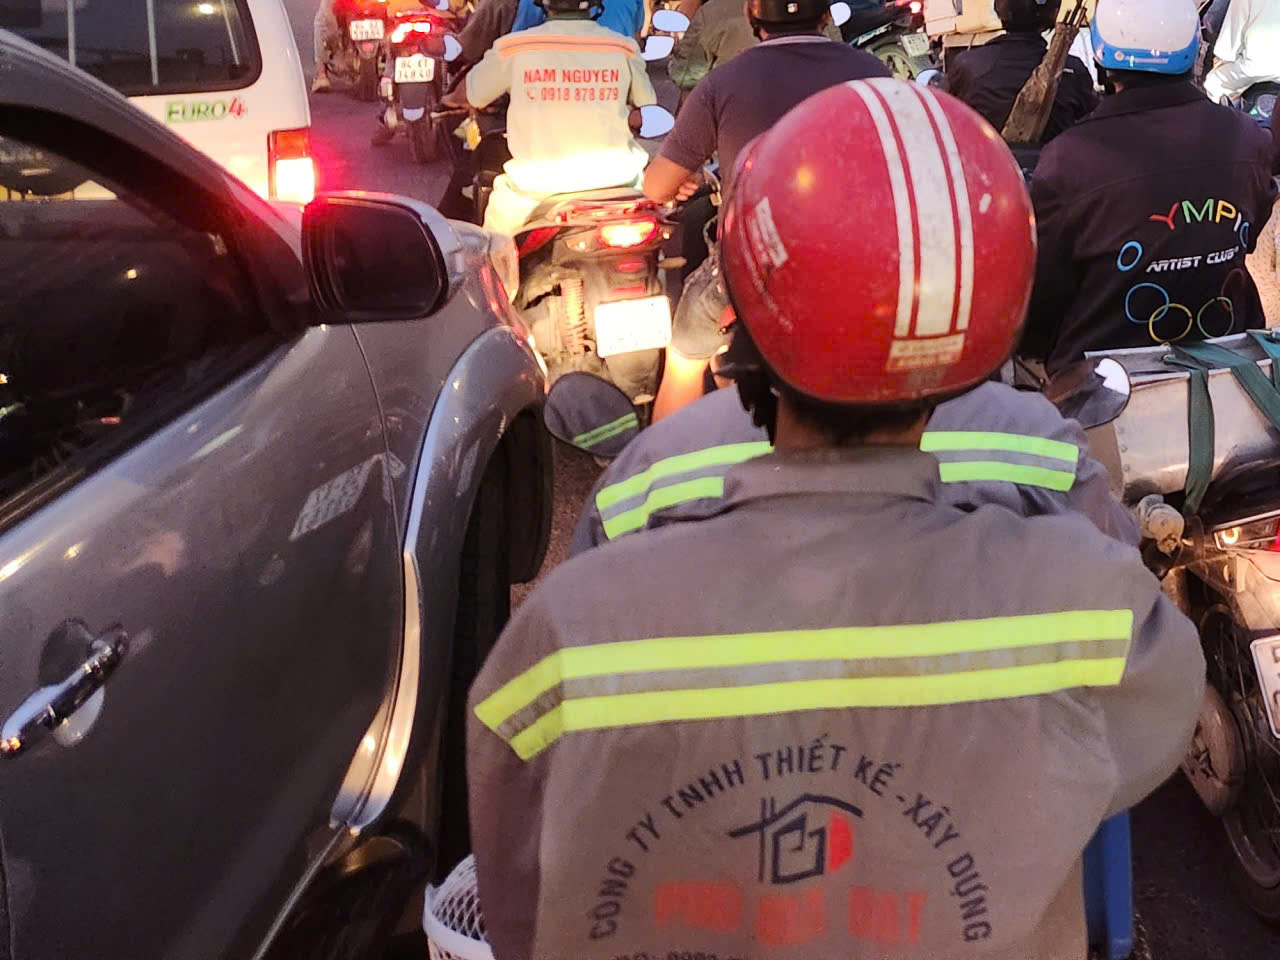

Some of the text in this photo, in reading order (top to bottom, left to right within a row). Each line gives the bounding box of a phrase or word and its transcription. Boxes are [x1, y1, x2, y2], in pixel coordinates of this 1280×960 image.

[524, 69, 619, 83] NAM NGUYEN
[1145, 255, 1202, 273] ARTIST
[590, 855, 635, 942] CÔNG
[627, 814, 661, 852] TY
[661, 759, 745, 819] TNHH
[757, 732, 847, 781] THIẾT
[946, 853, 992, 944] DỰNG
